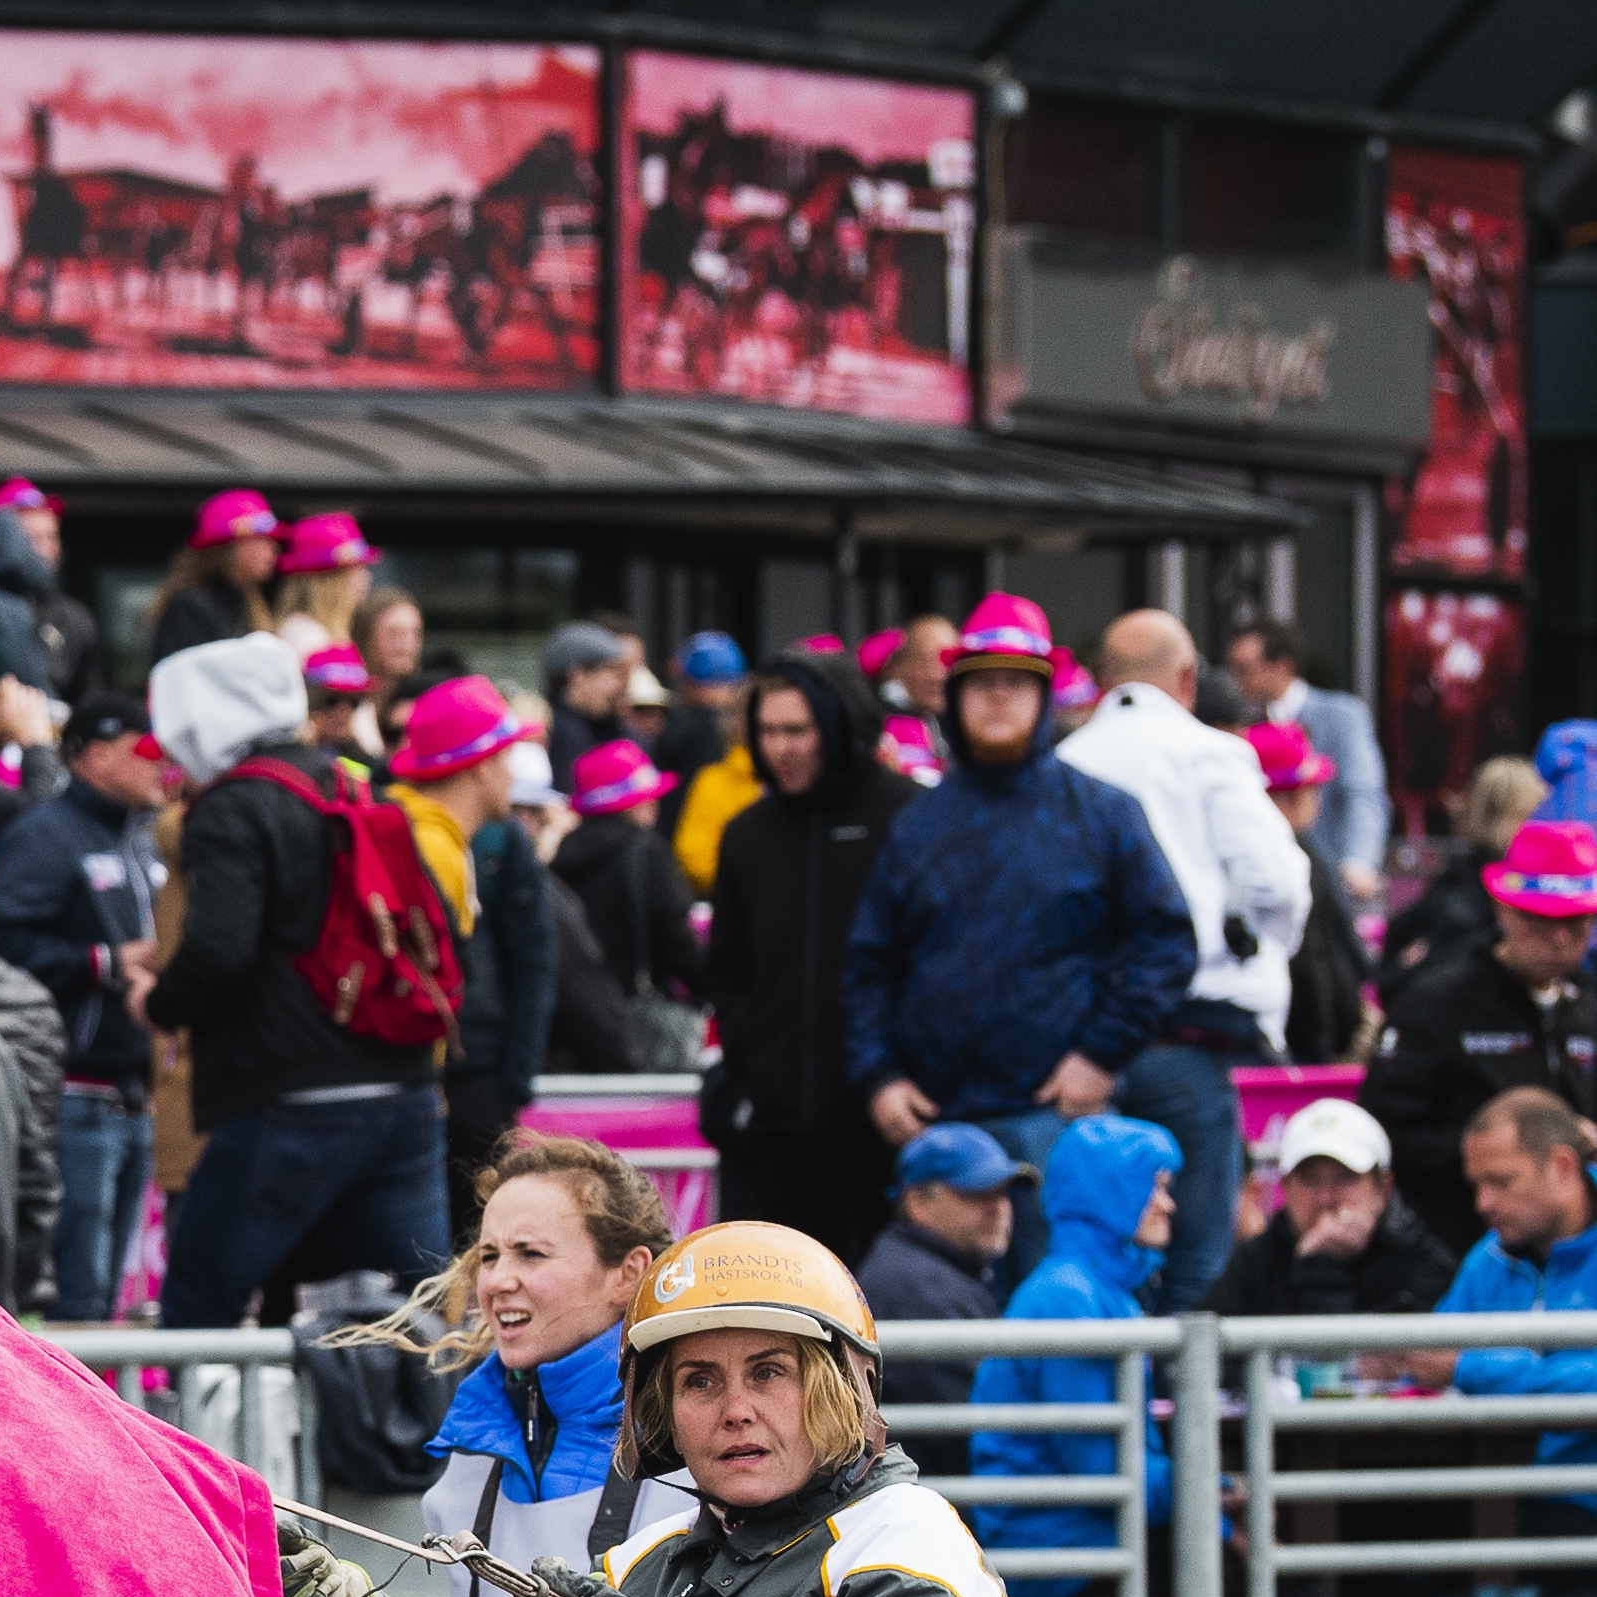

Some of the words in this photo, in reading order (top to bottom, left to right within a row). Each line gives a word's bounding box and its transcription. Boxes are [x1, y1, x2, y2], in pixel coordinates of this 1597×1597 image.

[704, 1254, 802, 1274] BRANDTS
[704, 1268, 781, 1283] HÄSTSKOR
[785, 1274, 803, 1288] AB
